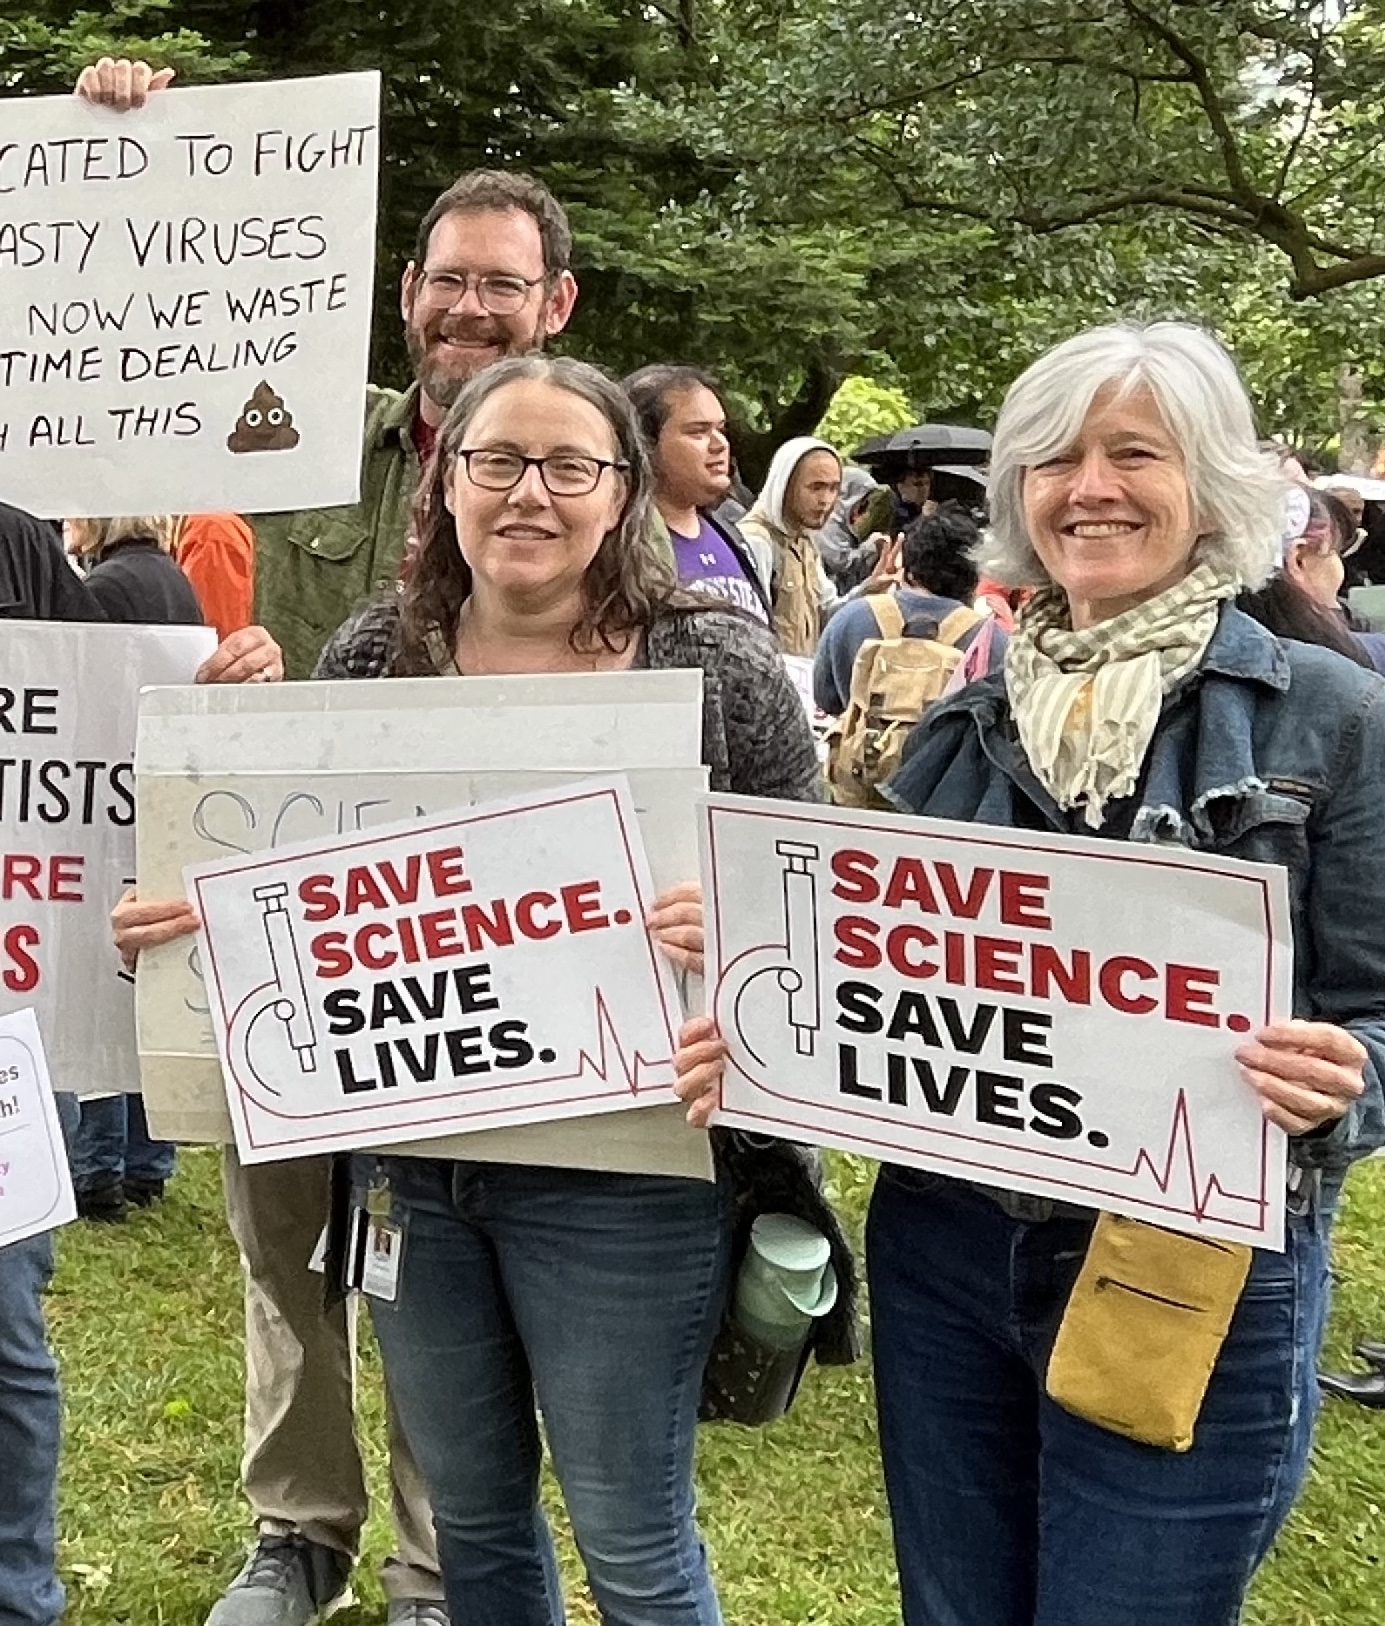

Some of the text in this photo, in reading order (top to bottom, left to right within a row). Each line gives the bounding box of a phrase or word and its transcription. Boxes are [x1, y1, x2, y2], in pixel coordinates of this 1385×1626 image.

[174, 134, 233, 176] TO
[255, 126, 376, 176] FIGHT
[126, 215, 327, 267] VIRUSES
[28, 293, 135, 336] NOW
[148, 291, 209, 329] WE
[226, 274, 348, 323] WASTE
[120, 332, 299, 382] DEALING
[29, 415, 95, 447] ALL
[109, 402, 202, 441] THIS
[297, 846, 472, 922] SAVE
[830, 850, 1052, 930] SAVE
[309, 880, 632, 979] SCIENCE.
[323, 964, 499, 1036] SAVE
[832, 916, 1251, 1033] SCIENCE.
[335, 1020, 556, 1095] LIVES.
[835, 981, 1053, 1069] SAVE
[838, 1044, 1109, 1148] LIVES.
